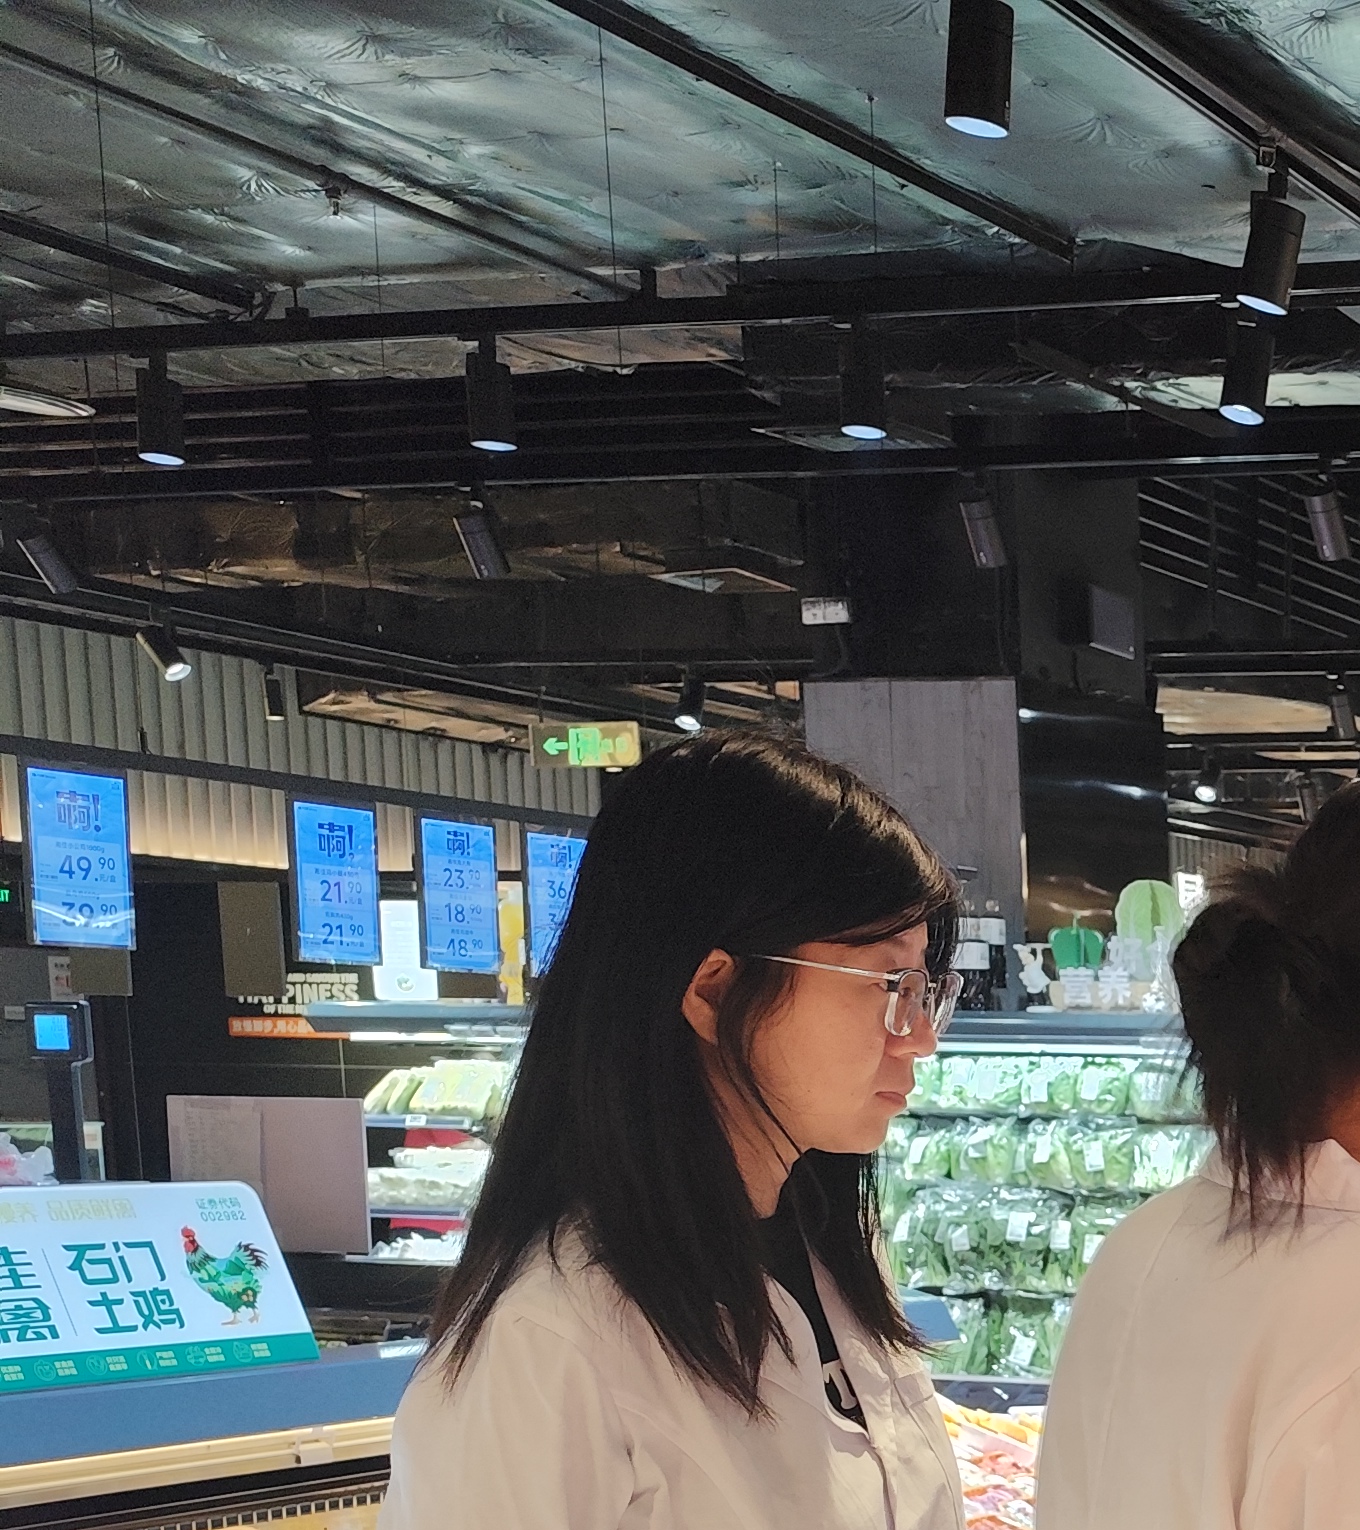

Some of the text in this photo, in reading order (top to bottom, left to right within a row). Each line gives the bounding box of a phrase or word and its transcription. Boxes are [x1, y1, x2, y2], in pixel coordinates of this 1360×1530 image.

[199, 1210, 247, 1222] 002982
[61, 1239, 168, 1287] 石门
[87, 1286, 186, 1334] 土鸡
